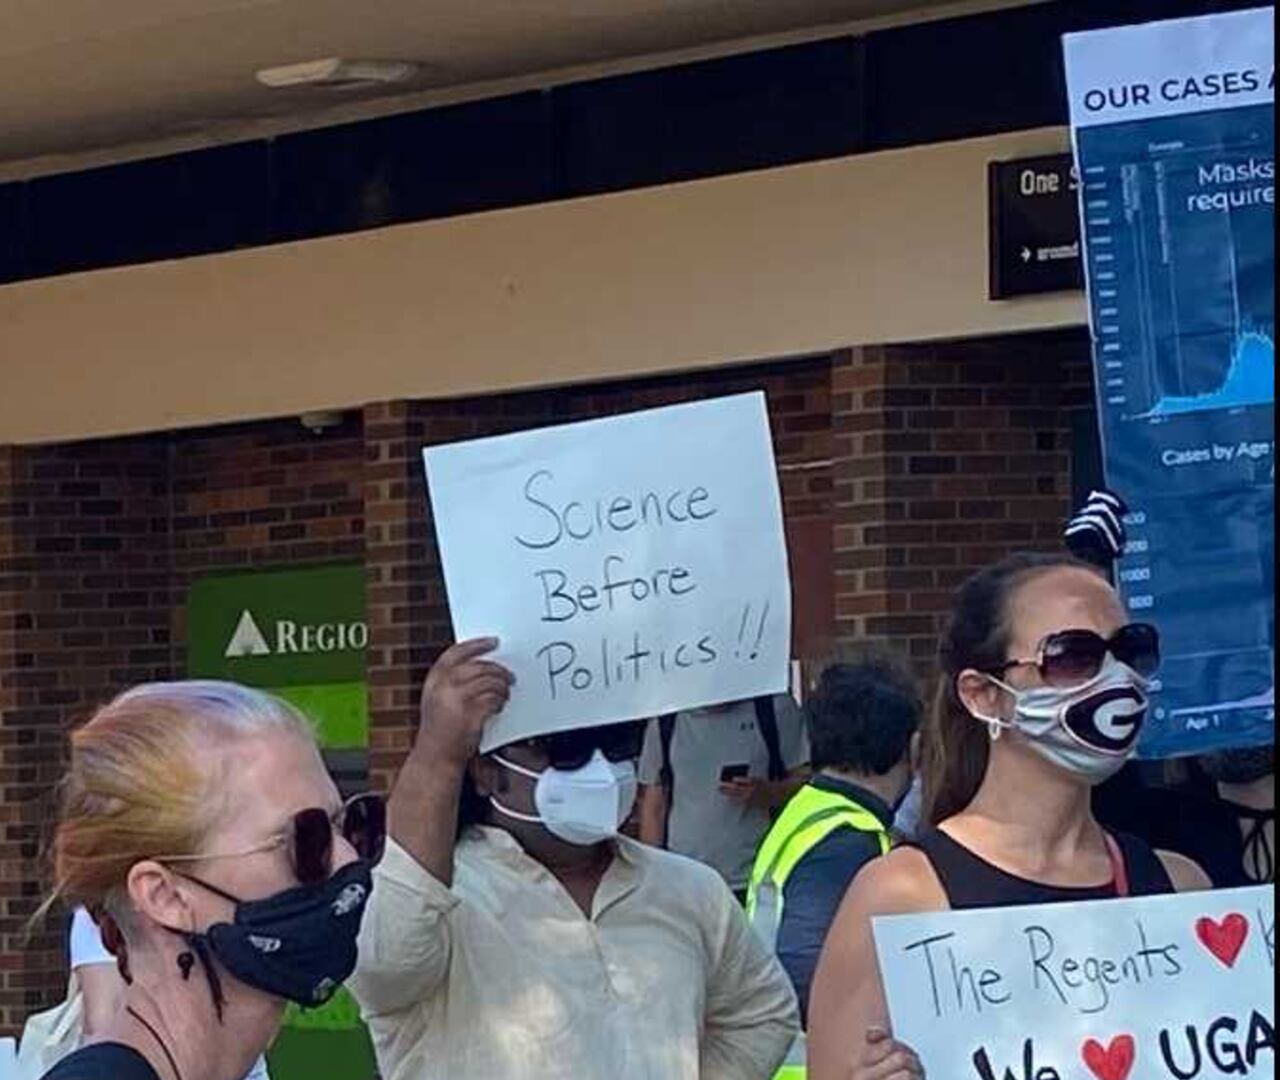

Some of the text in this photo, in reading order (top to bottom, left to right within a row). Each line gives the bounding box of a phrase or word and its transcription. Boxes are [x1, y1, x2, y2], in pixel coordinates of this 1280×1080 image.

[1084, 83, 1151, 112] OUR
[1160, 69, 1259, 103] CASES
[1020, 169, 1059, 195] One
[1197, 157, 1275, 186] Masks
[1187, 186, 1275, 213] require
[1212, 443, 1235, 461] by
[1236, 441, 1270, 459] Age
[514, 469, 721, 550] Science
[534, 555, 698, 623] Before
[905, 930, 1013, 1017] The
[1023, 914, 1184, 1014] Regents
